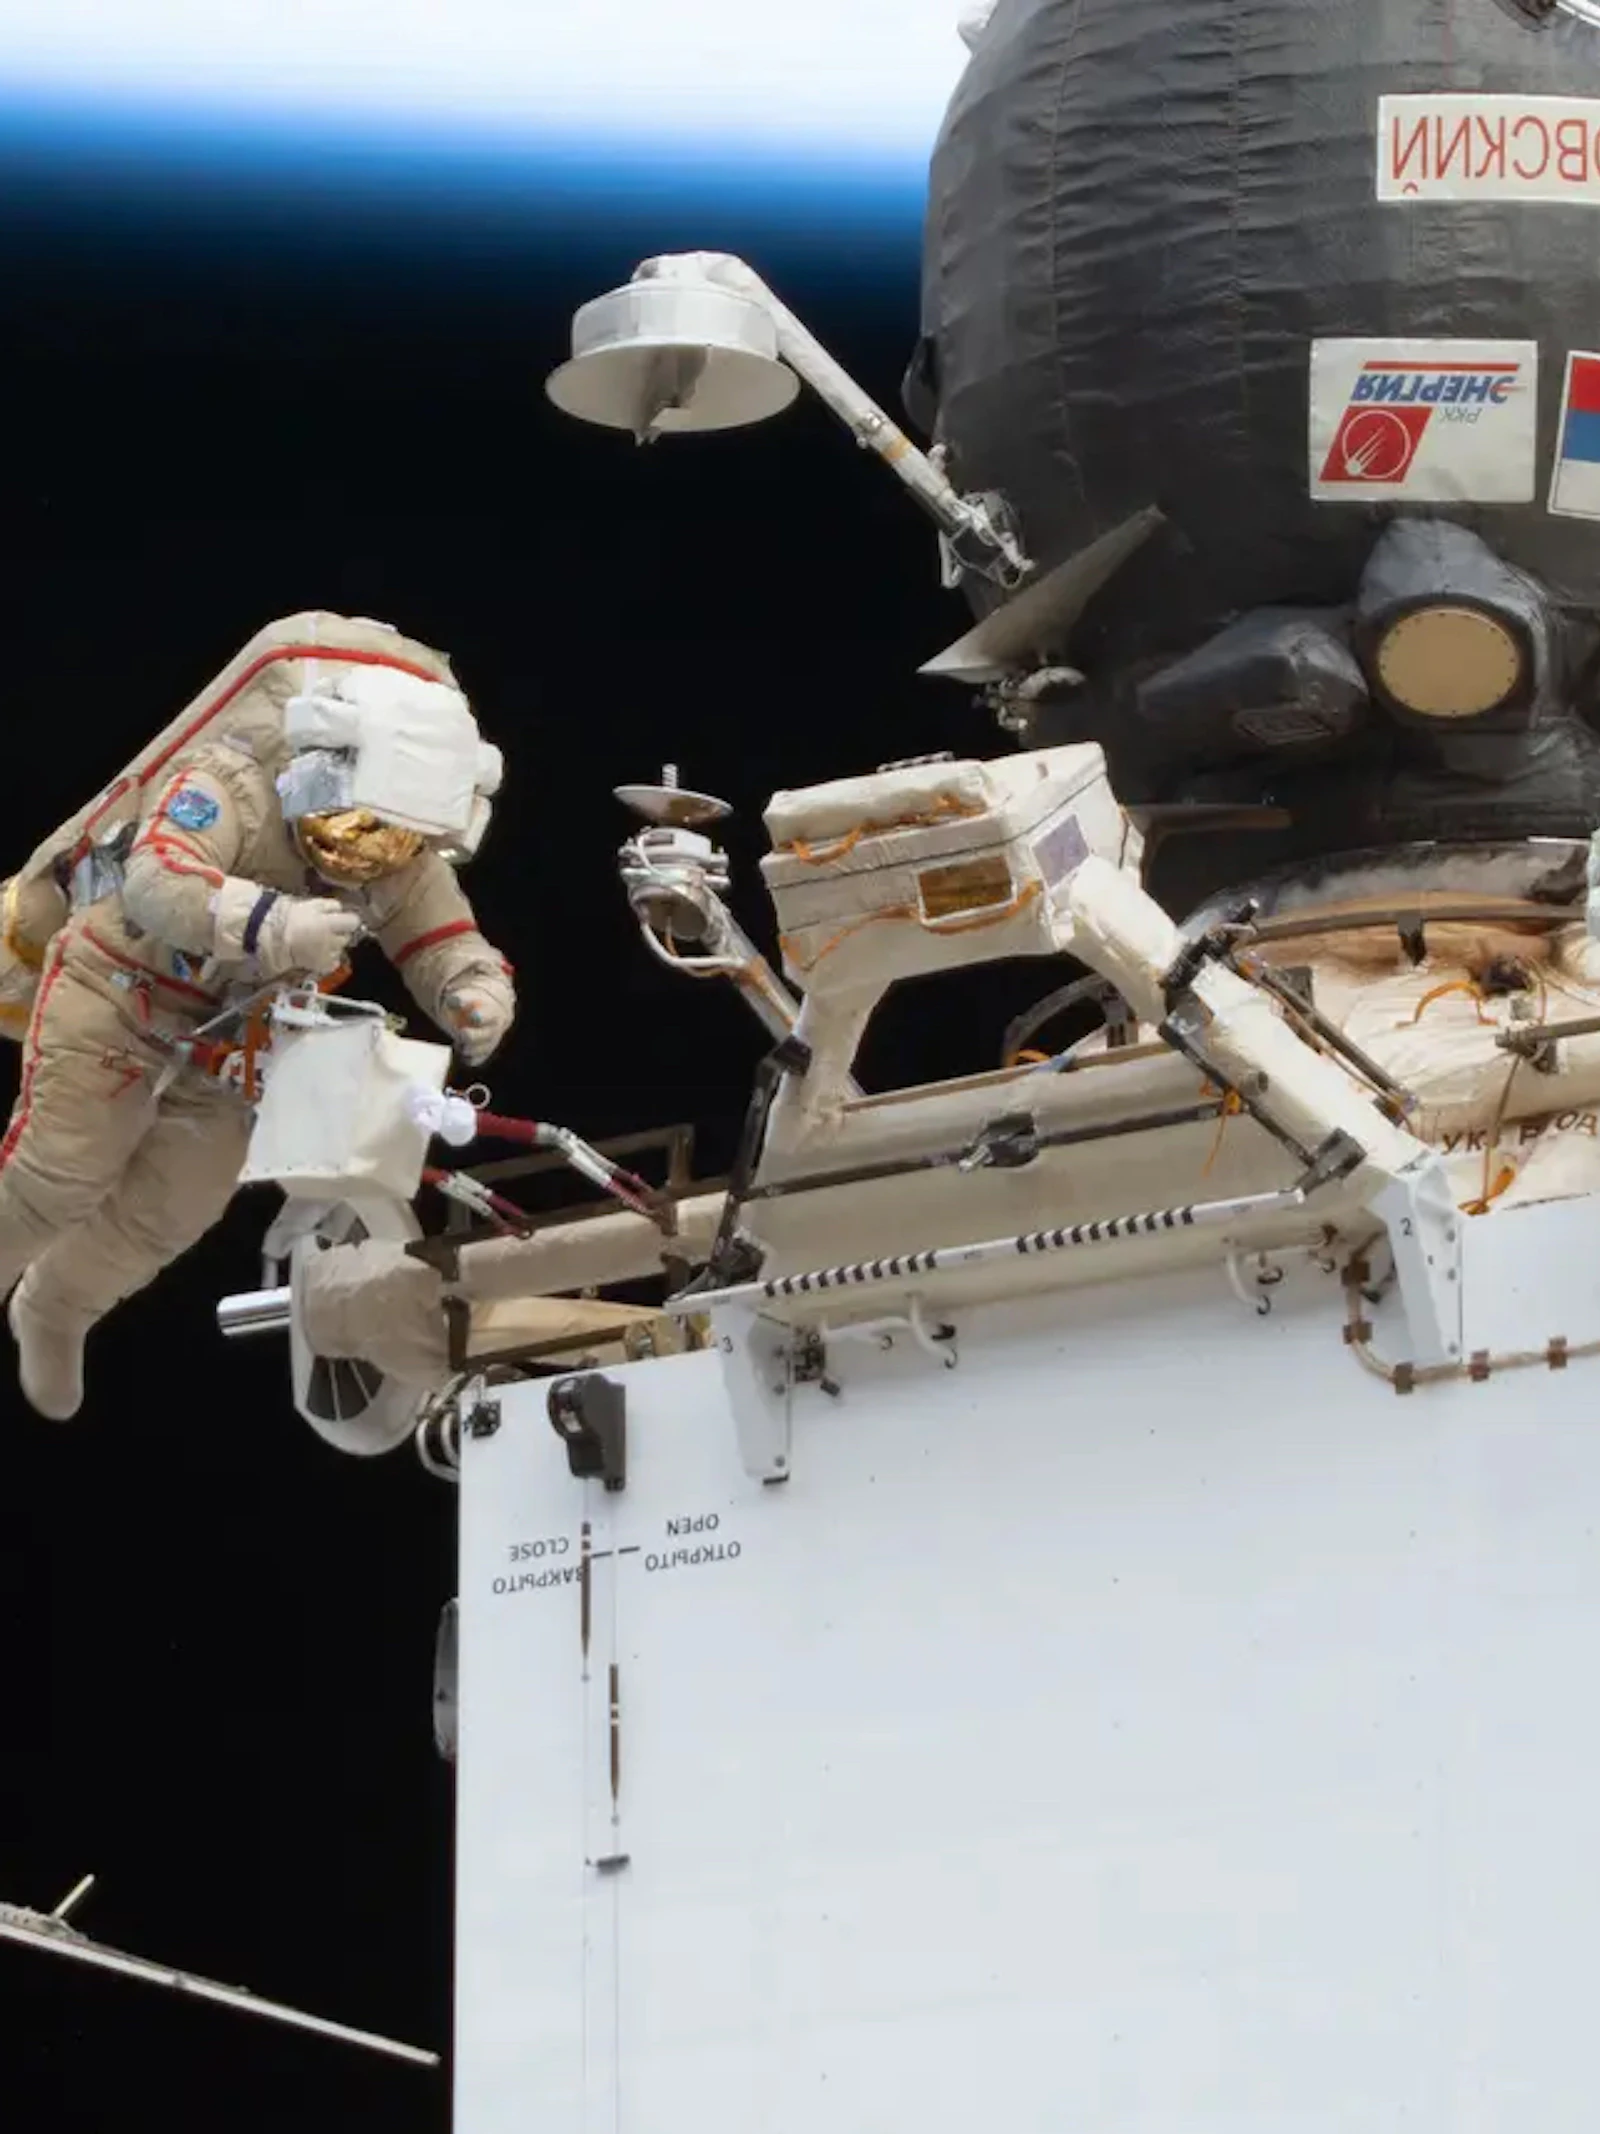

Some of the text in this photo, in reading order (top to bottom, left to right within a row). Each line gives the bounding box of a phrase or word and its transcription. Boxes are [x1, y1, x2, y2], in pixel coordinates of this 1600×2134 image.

[1392, 115, 1600, 194] ВСКИЙ
[1351, 374, 1516, 403] ЭНЕРГИЯ
[1439, 406, 1482, 424] РКК
[1400, 1217, 1412, 1236] 2
[722, 1334, 733, 1353] 3
[667, 1513, 719, 1536] OPEN
[509, 1536, 569, 1561] CLOSE
[645, 1541, 741, 1571] ОТКРЫТО
